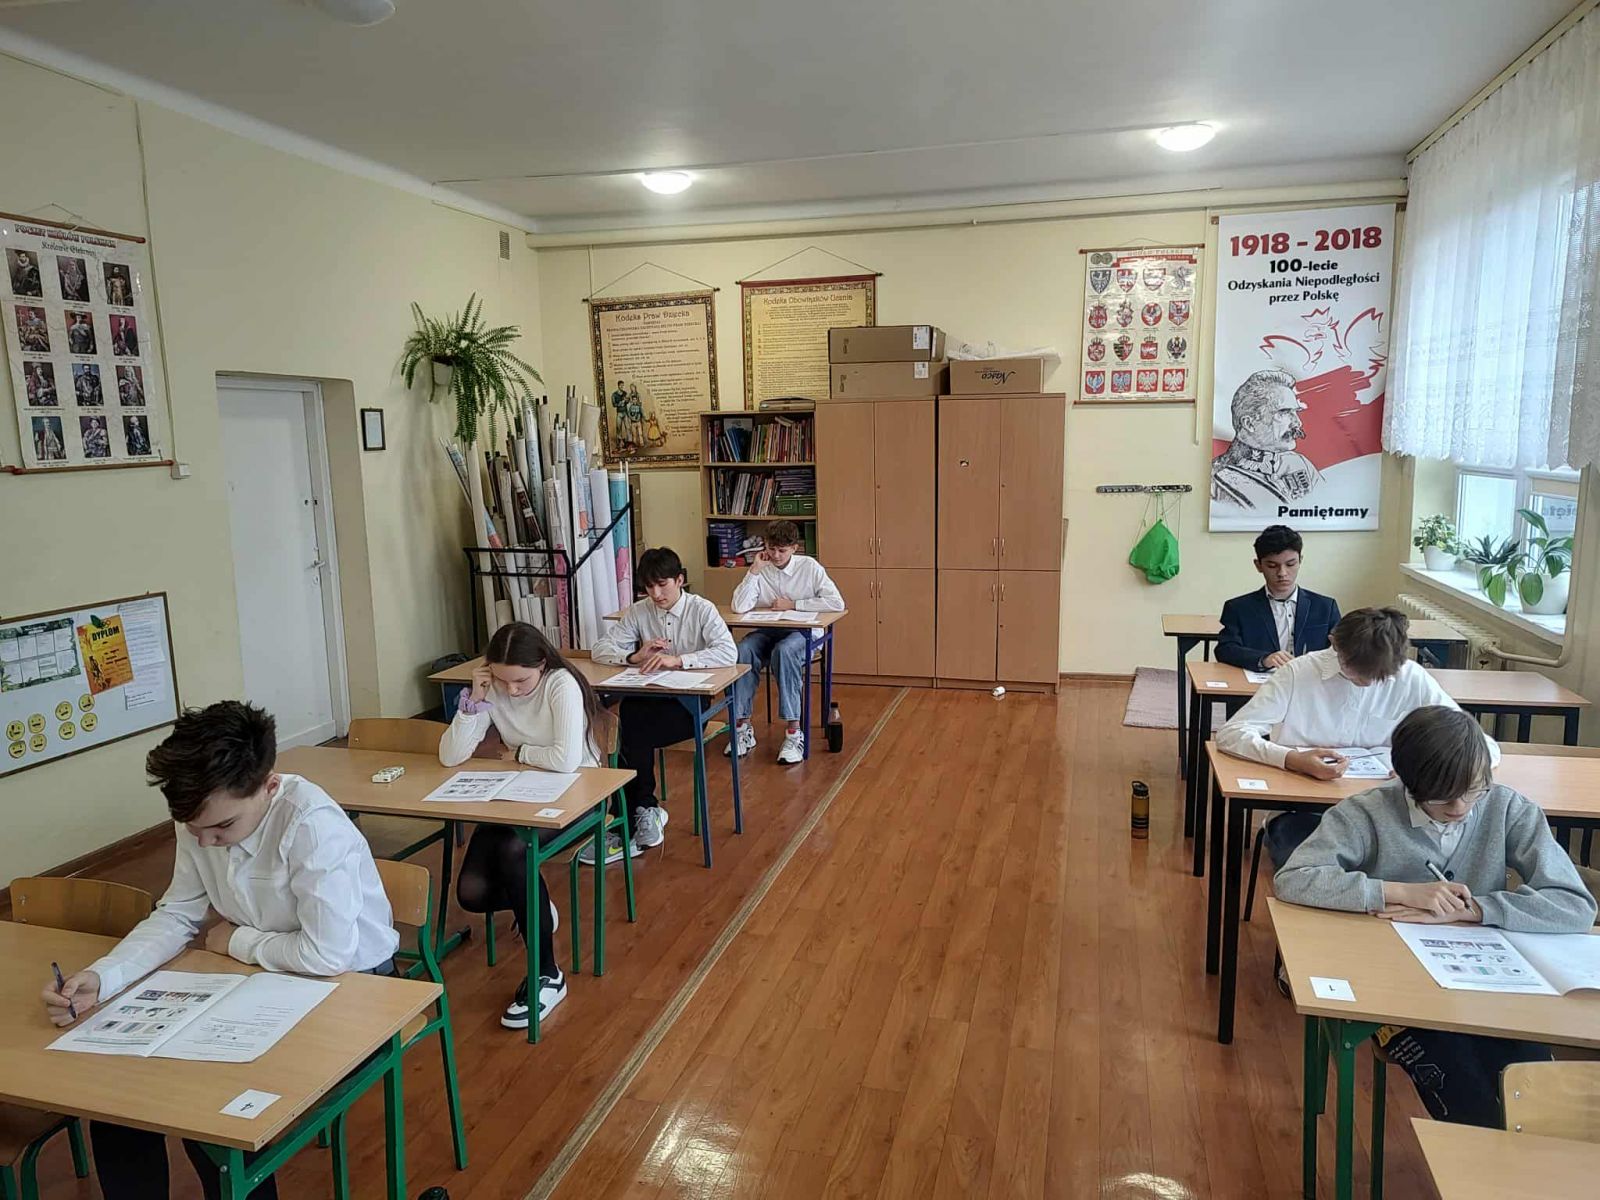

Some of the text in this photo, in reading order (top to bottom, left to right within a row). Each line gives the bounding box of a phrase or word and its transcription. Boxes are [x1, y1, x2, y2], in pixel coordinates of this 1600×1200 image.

[1230, 232, 1290, 257] 1918
[1314, 226, 1382, 252] 2018
[1269, 258, 1338, 274] 100-lecie
[1227, 272, 1380, 293] Odzyskania Niepodległości
[1269, 290, 1340, 306] przez Polskę
[615, 313, 641, 323] Kodeks
[643, 312, 661, 321] Praw
[663, 310, 690, 319] Dziecka
[1277, 505, 1369, 520] Pamiętamy
[91, 626, 120, 641] DYPLOM
